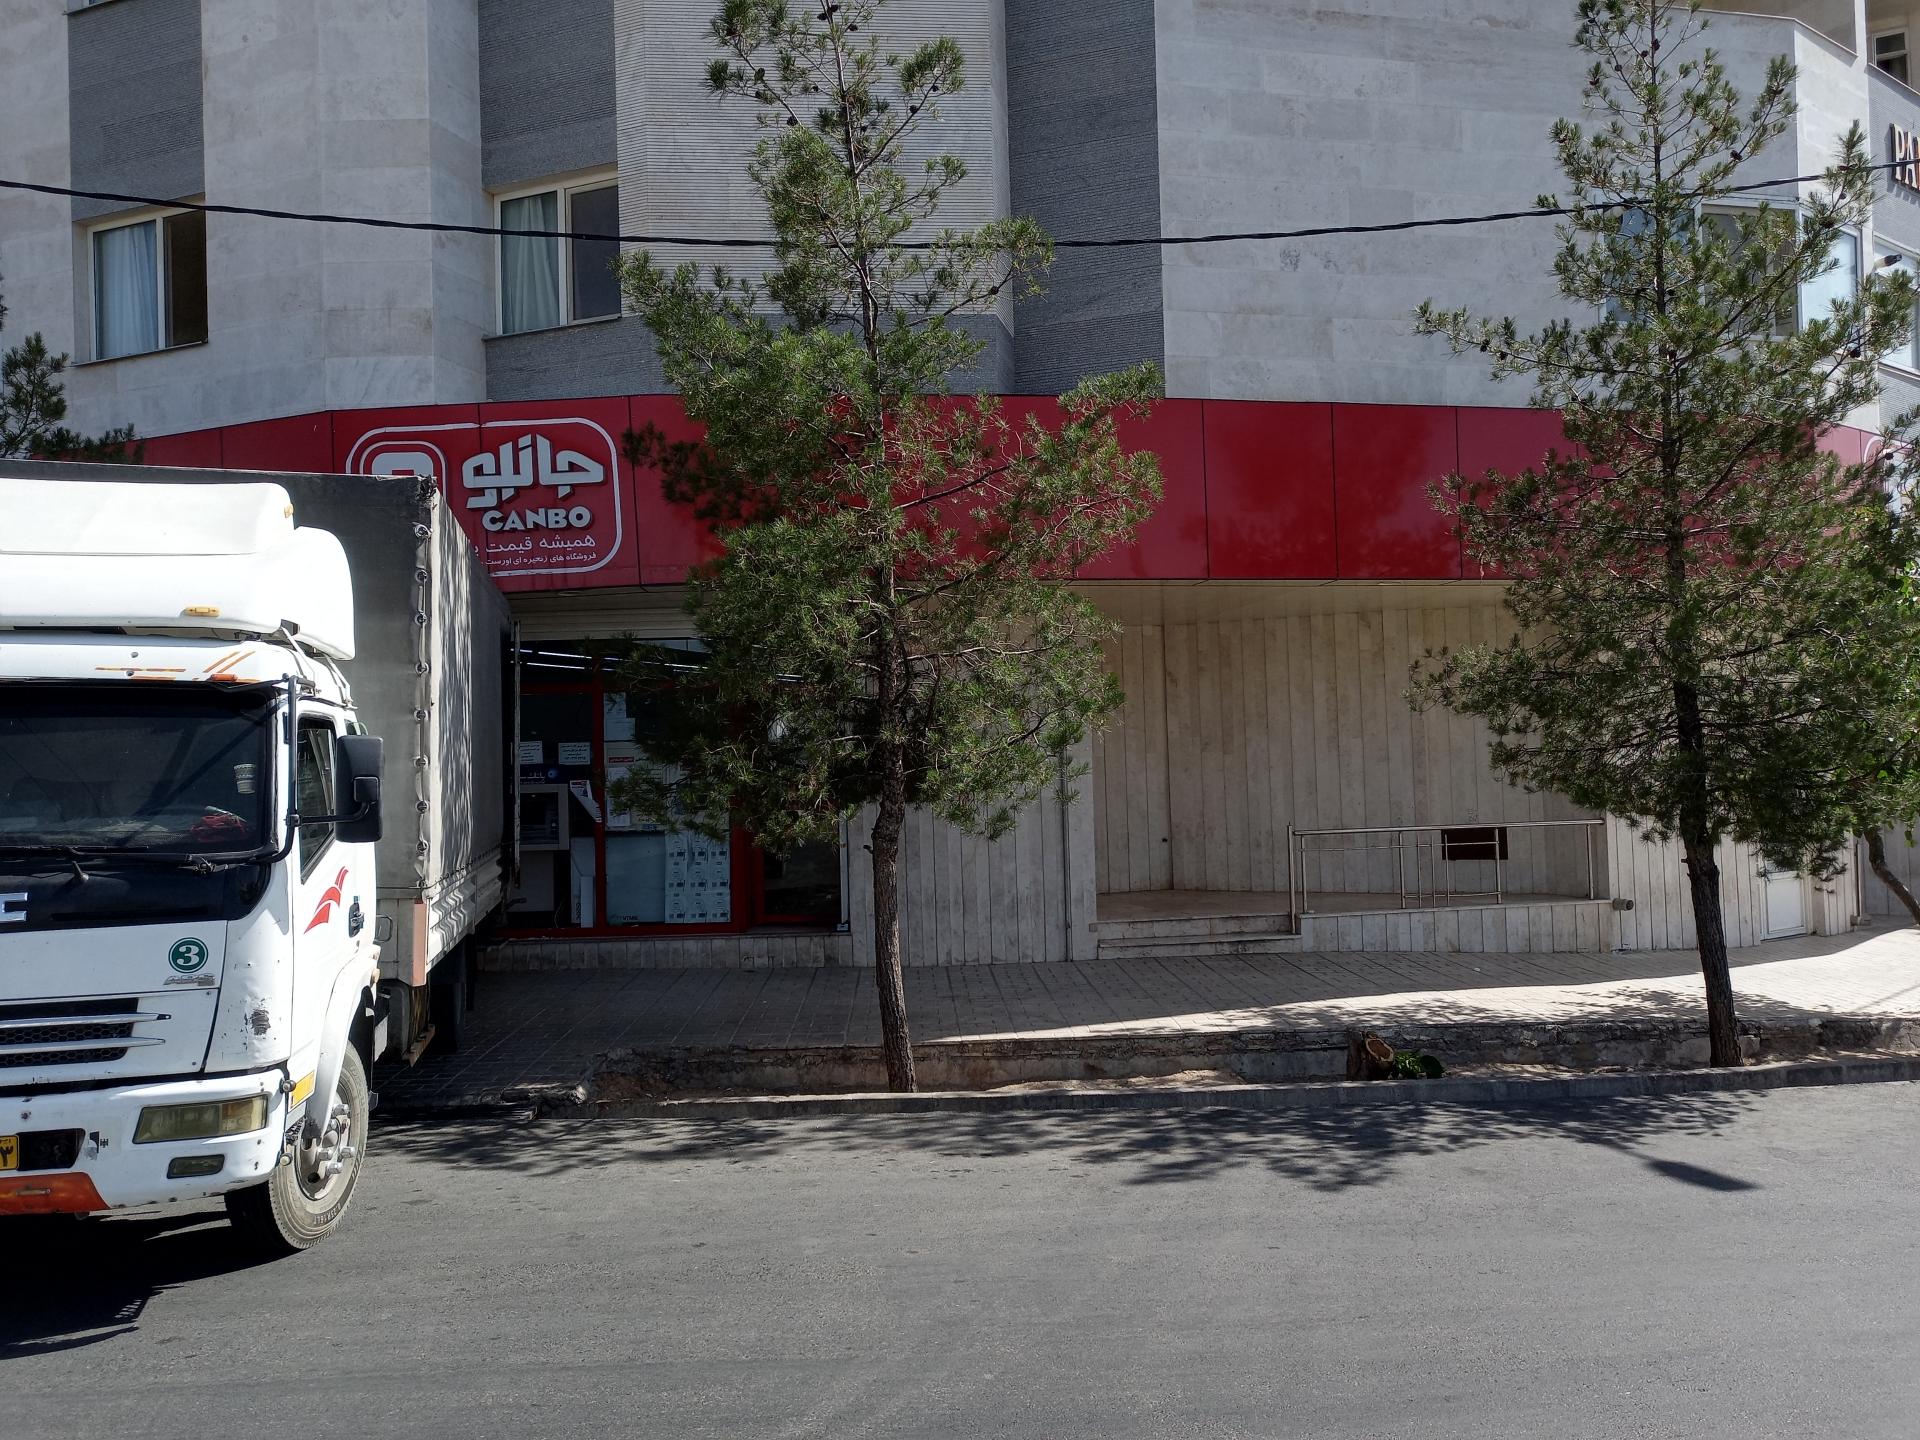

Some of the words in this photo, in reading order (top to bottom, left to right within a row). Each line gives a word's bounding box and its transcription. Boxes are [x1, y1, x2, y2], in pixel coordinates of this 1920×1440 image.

[462, 434, 603, 508] جانبو
[482, 506, 591, 531] CANBO
[485, 536, 533, 554] قیمت
[539, 534, 596, 551] همیشه
[549, 555, 565, 563] های
[566, 551, 597, 561] فروشگاه
[176, 944, 200, 966] 3
